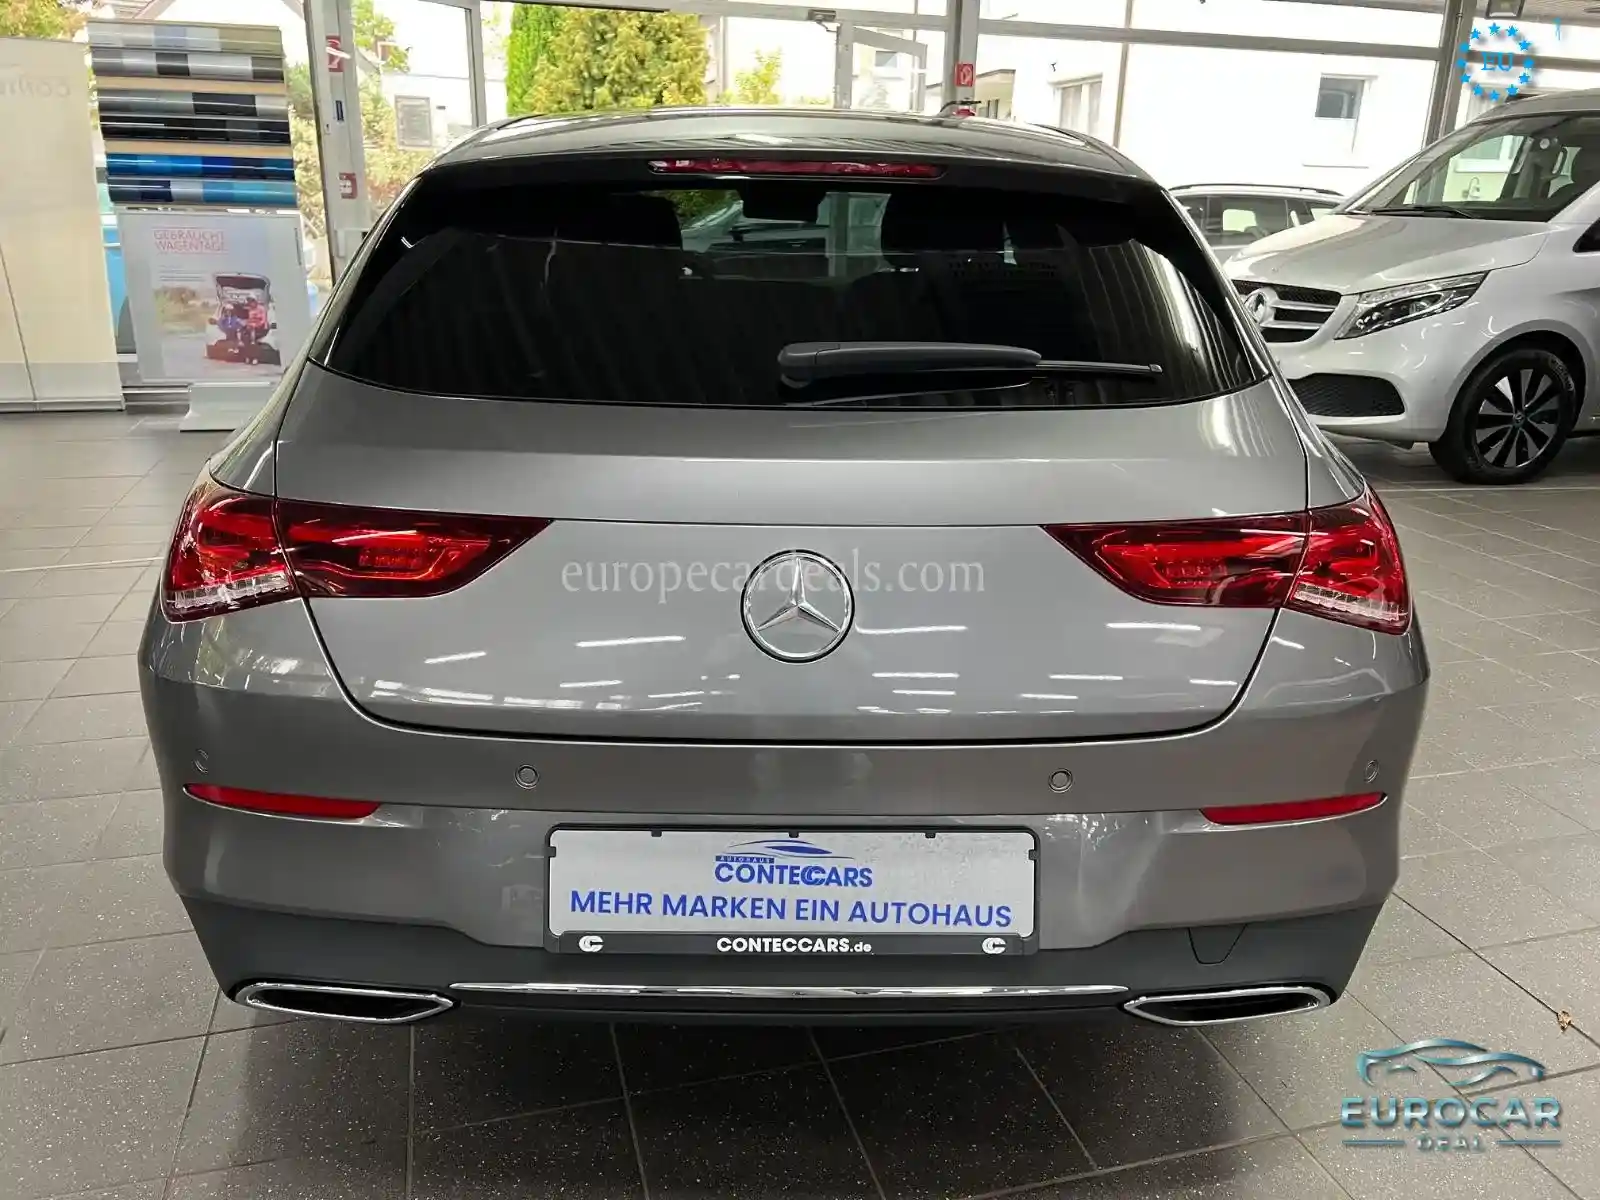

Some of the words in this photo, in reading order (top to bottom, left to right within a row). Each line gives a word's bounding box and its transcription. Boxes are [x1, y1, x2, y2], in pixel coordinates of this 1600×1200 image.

[570, 890, 652, 915] MEHR
[662, 893, 786, 920] MARKEN
[795, 898, 839, 921] EIN
[848, 900, 1012, 928] AUTOHAUS
[716, 937, 873, 953] CONTECCARS.de
